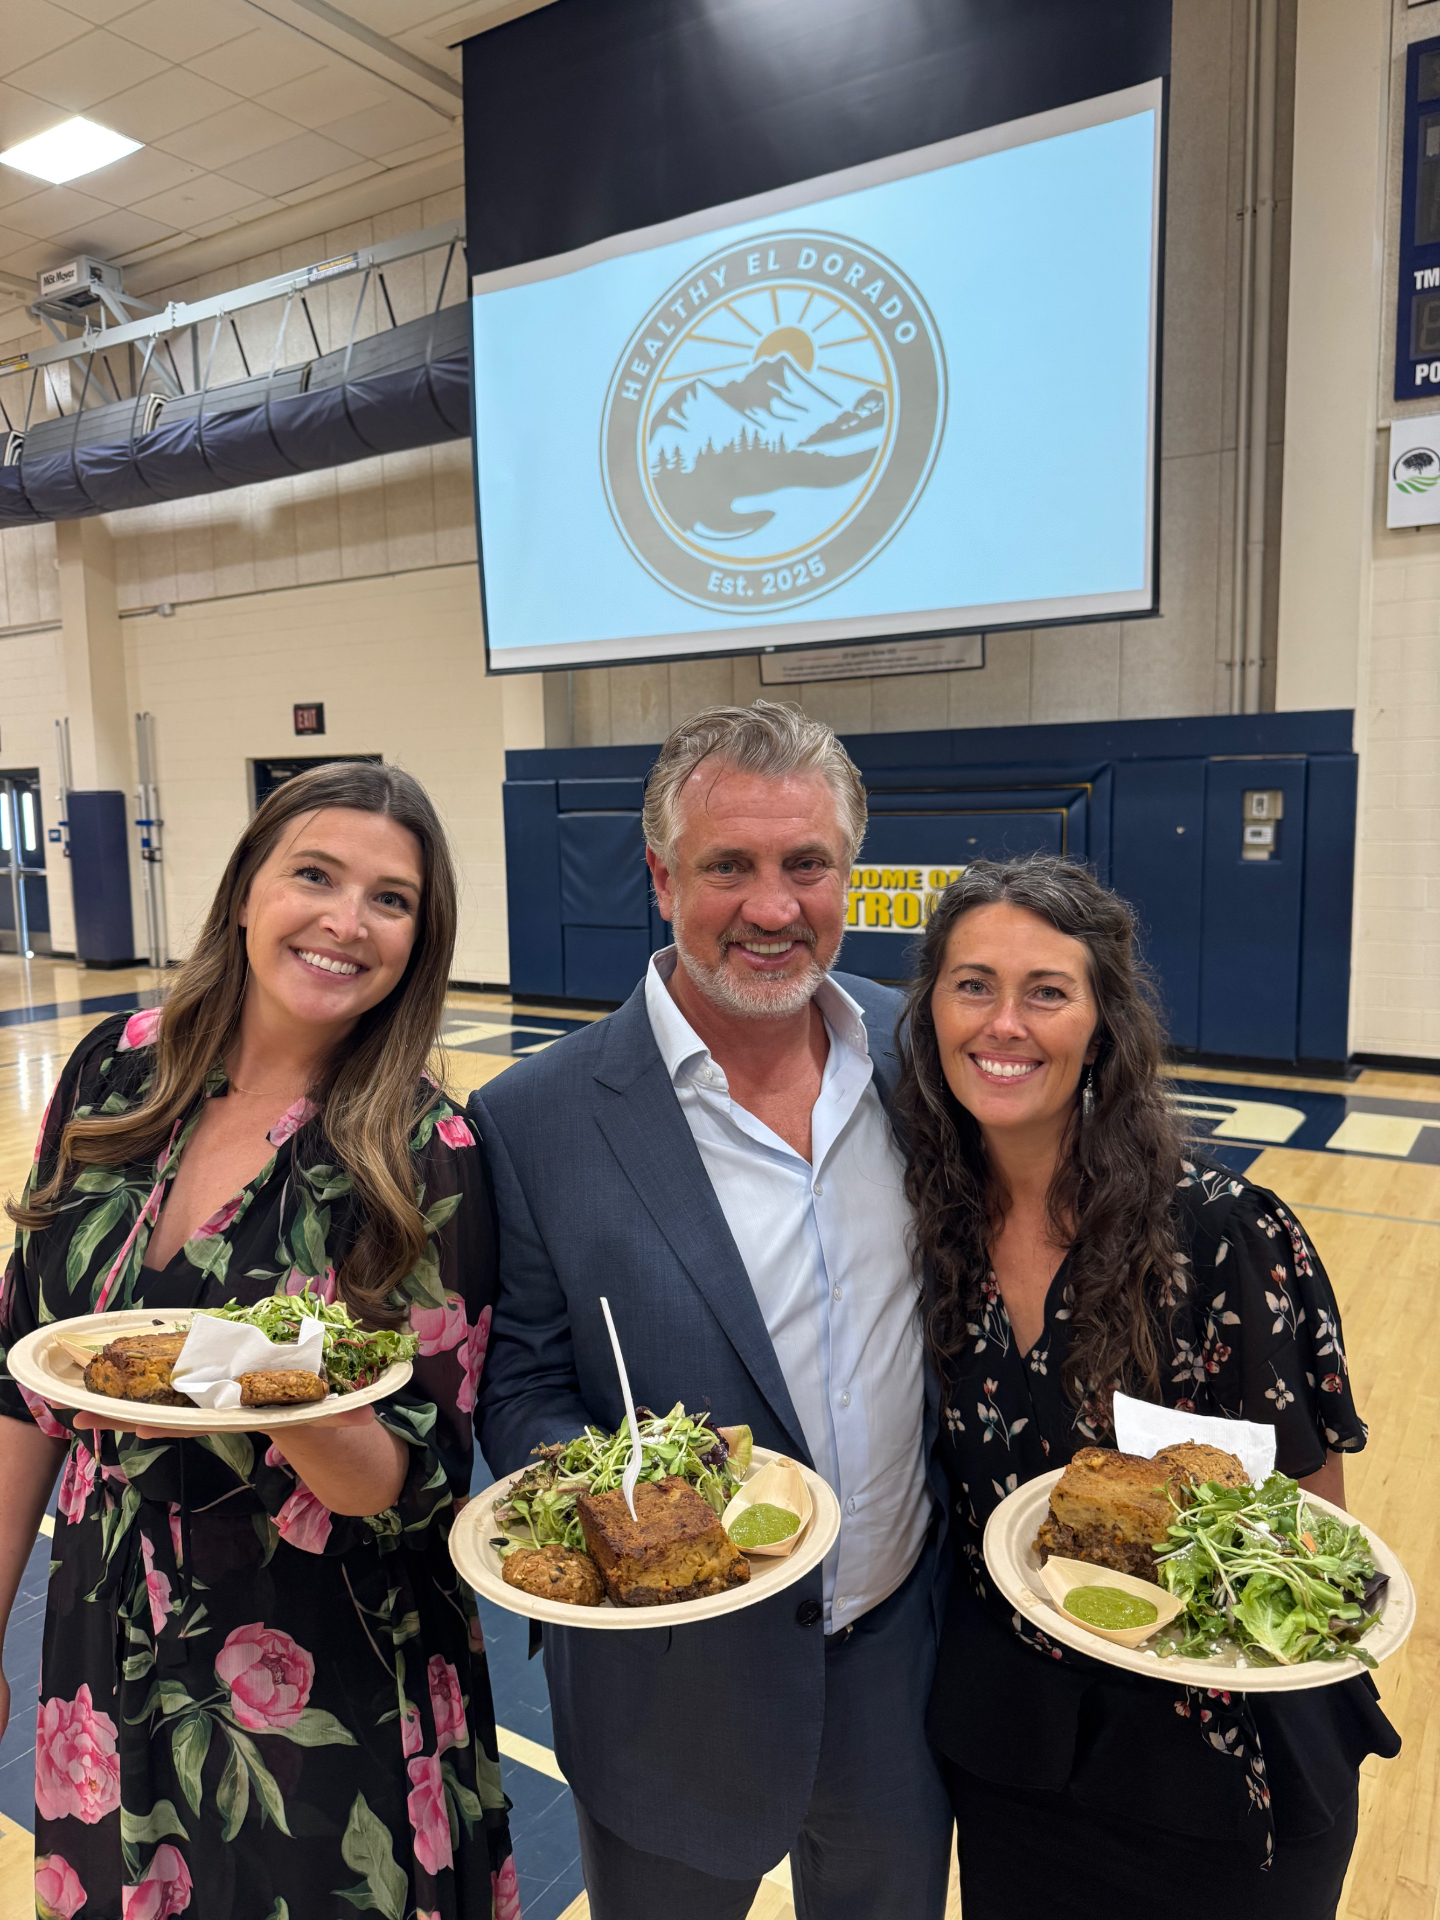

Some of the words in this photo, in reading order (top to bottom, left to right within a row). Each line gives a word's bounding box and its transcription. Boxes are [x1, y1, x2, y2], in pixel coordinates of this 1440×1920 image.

[621, 264, 727, 401] HEALTHY
[747, 249, 780, 276] EL
[797, 247, 917, 345] DORADO
[707, 569, 754, 597] Est.
[761, 554, 826, 595] 2025
[297, 708, 317, 729] EXIT
